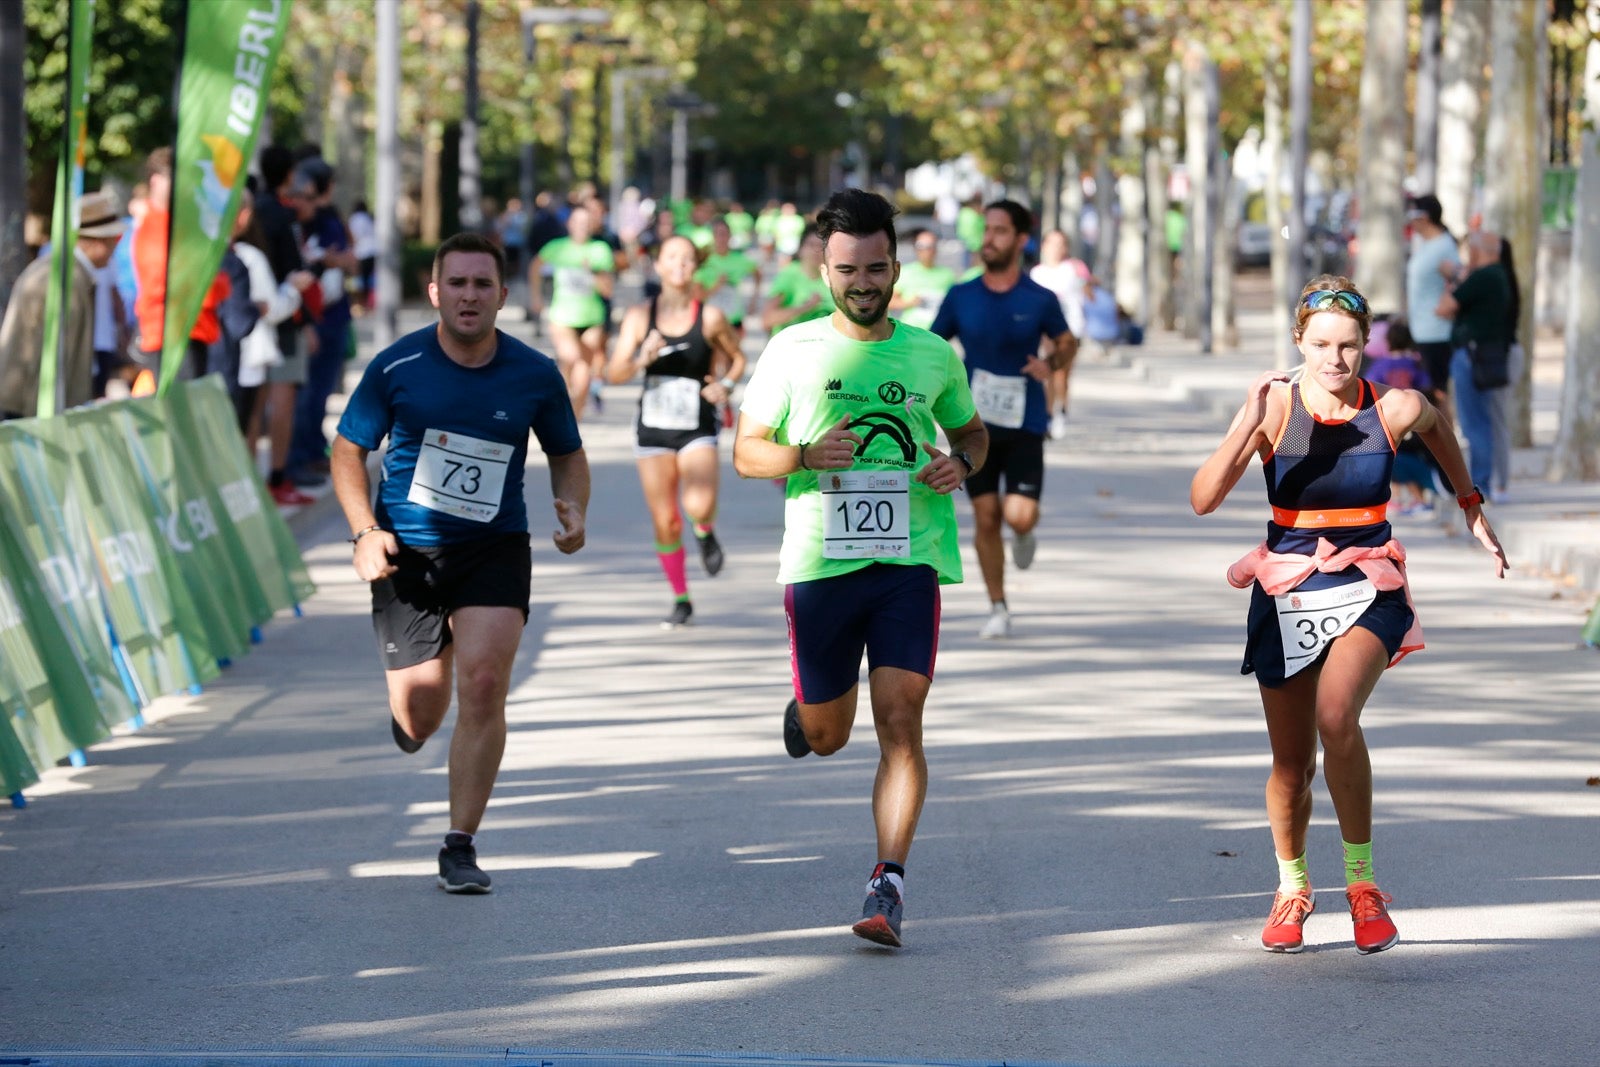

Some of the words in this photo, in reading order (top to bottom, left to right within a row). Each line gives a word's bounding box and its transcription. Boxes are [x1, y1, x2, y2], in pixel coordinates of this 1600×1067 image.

[827, 392, 870, 403] IBERDROLA
[441, 459, 482, 495] 73
[837, 500, 894, 533] 120
[1295, 611, 1357, 651] 39
